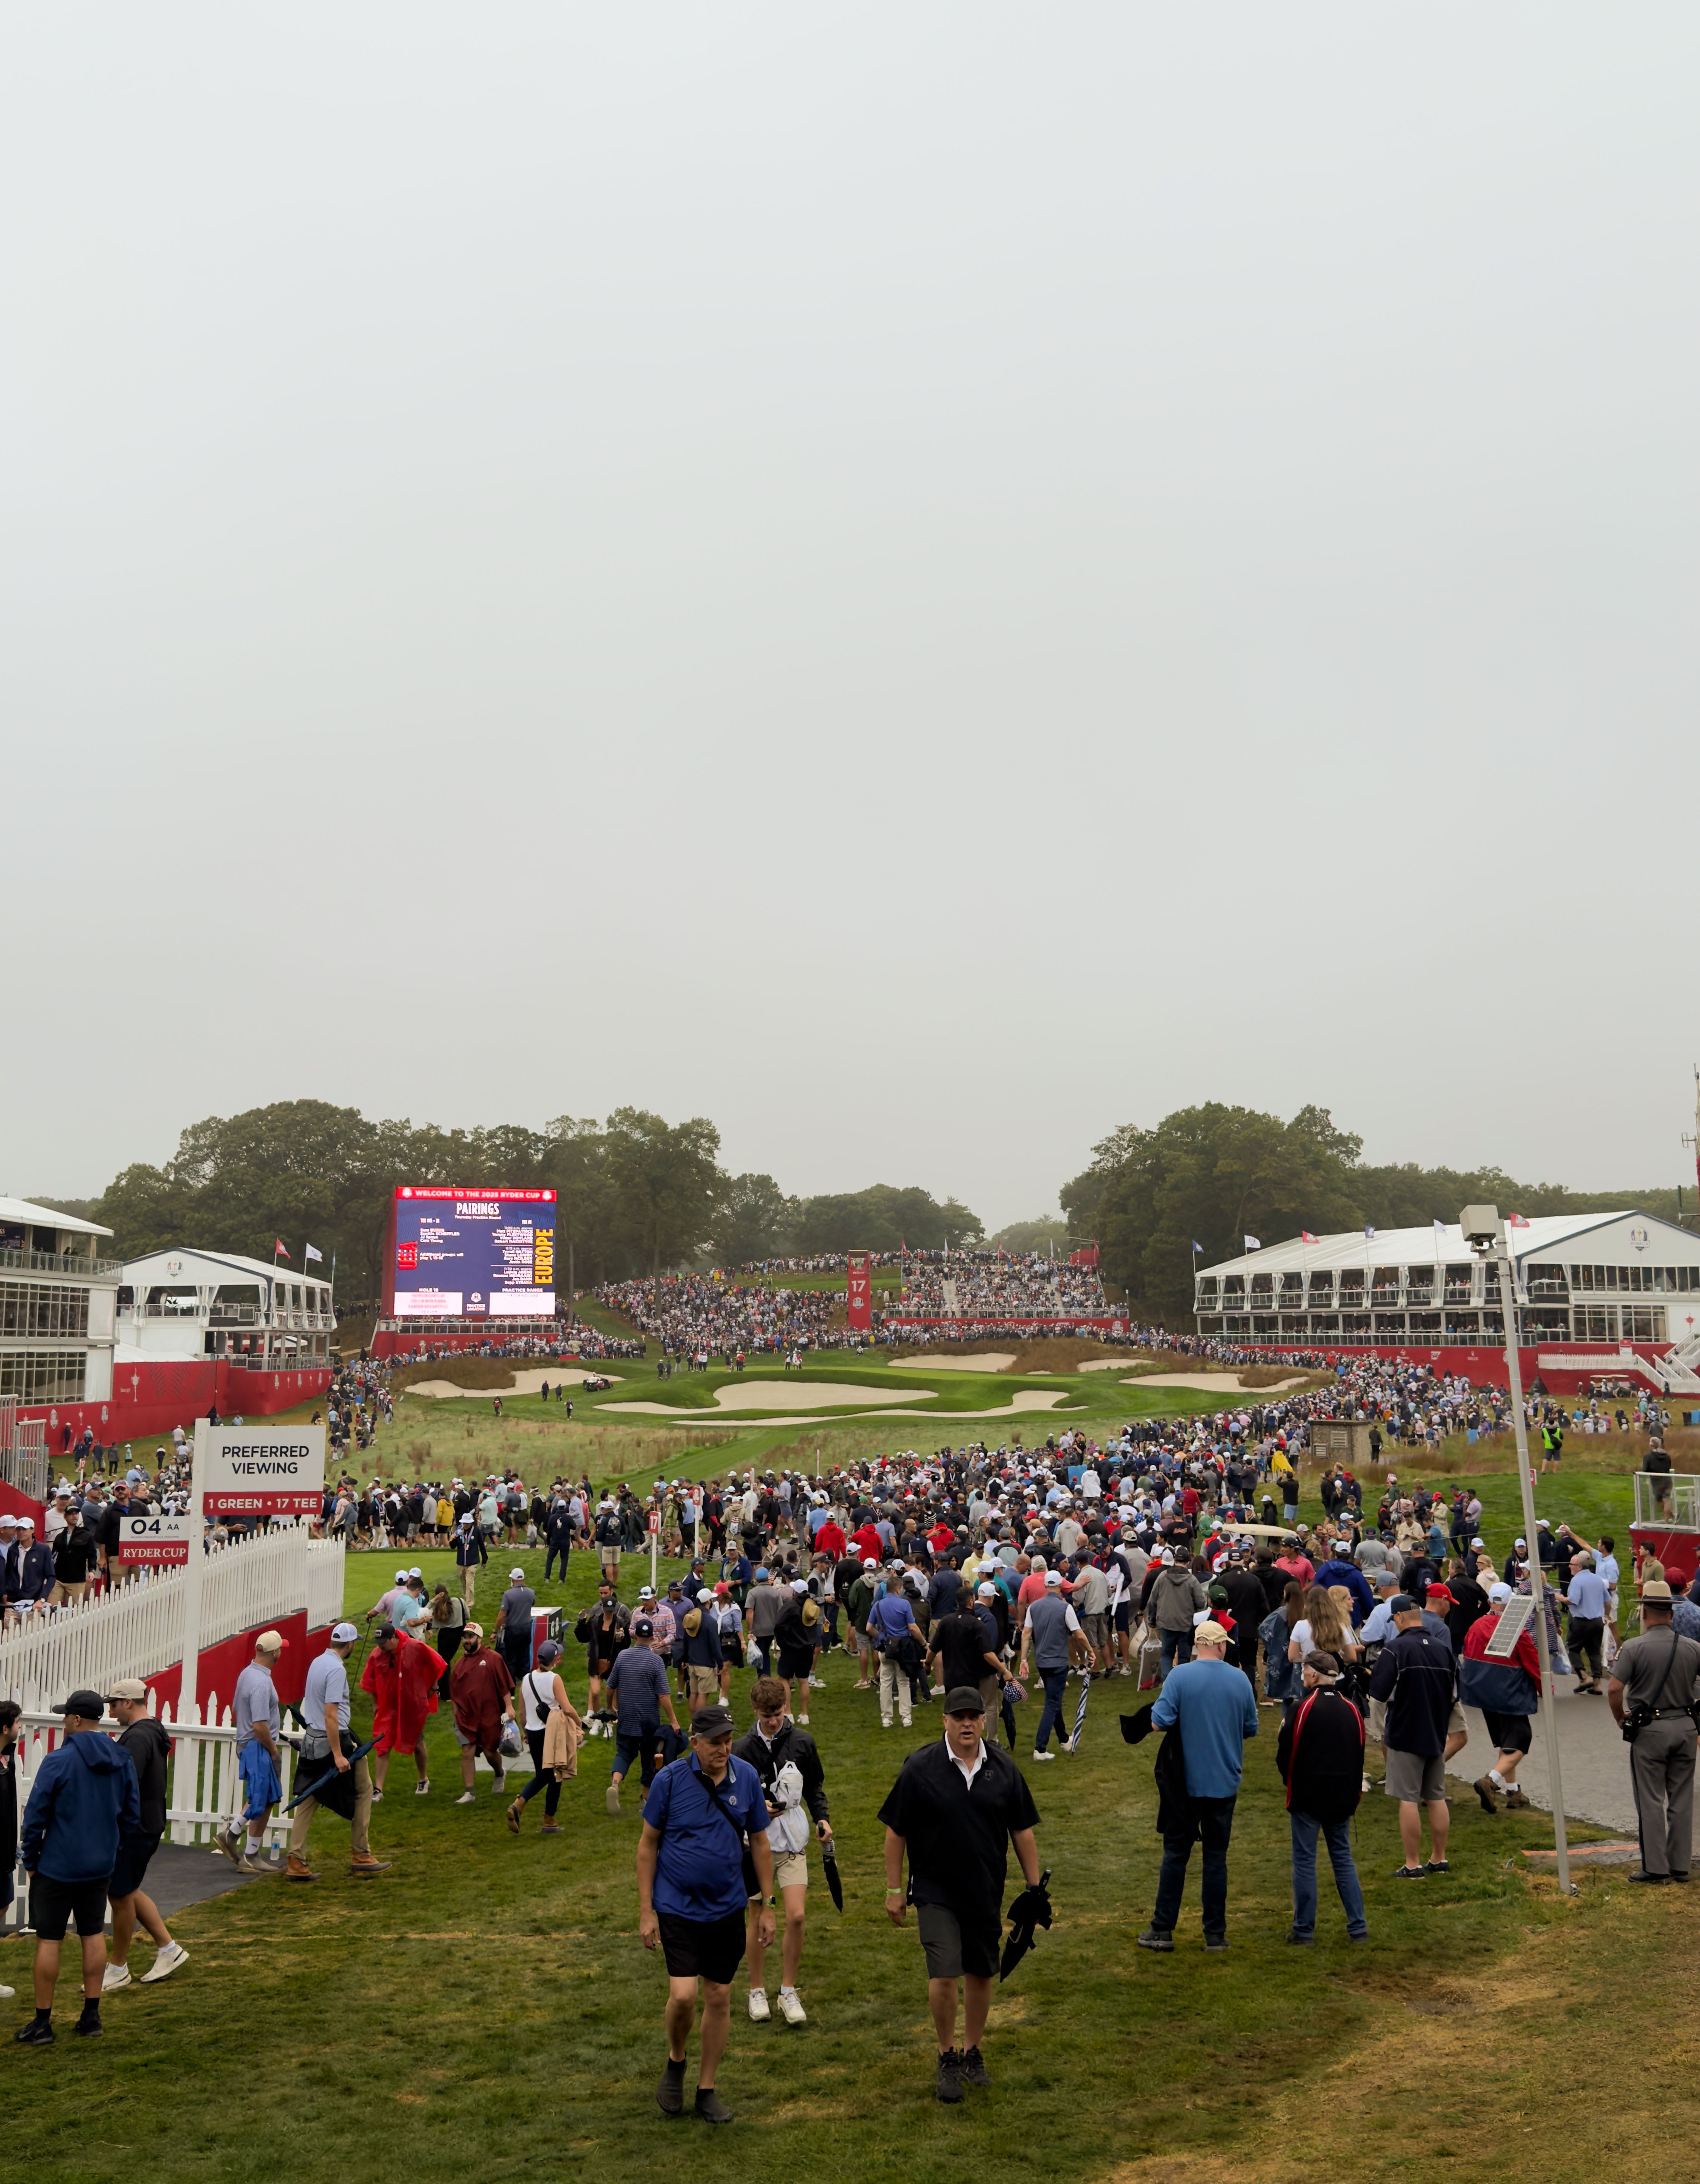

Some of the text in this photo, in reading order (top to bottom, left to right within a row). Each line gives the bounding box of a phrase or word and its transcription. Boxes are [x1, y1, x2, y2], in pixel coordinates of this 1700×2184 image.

[456, 1202, 499, 1215] PAIRINGS
[534, 1228, 553, 1284] EUROPE
[852, 1280, 866, 1292] 17
[222, 1446, 309, 1458] PREFERRED
[232, 1462, 298, 1474] VIEWING
[208, 1498, 317, 1509] 1 GREEN 17 TEE
[650, 1515, 658, 1529] 17
[123, 1548, 186, 1557] RYDER CUP
